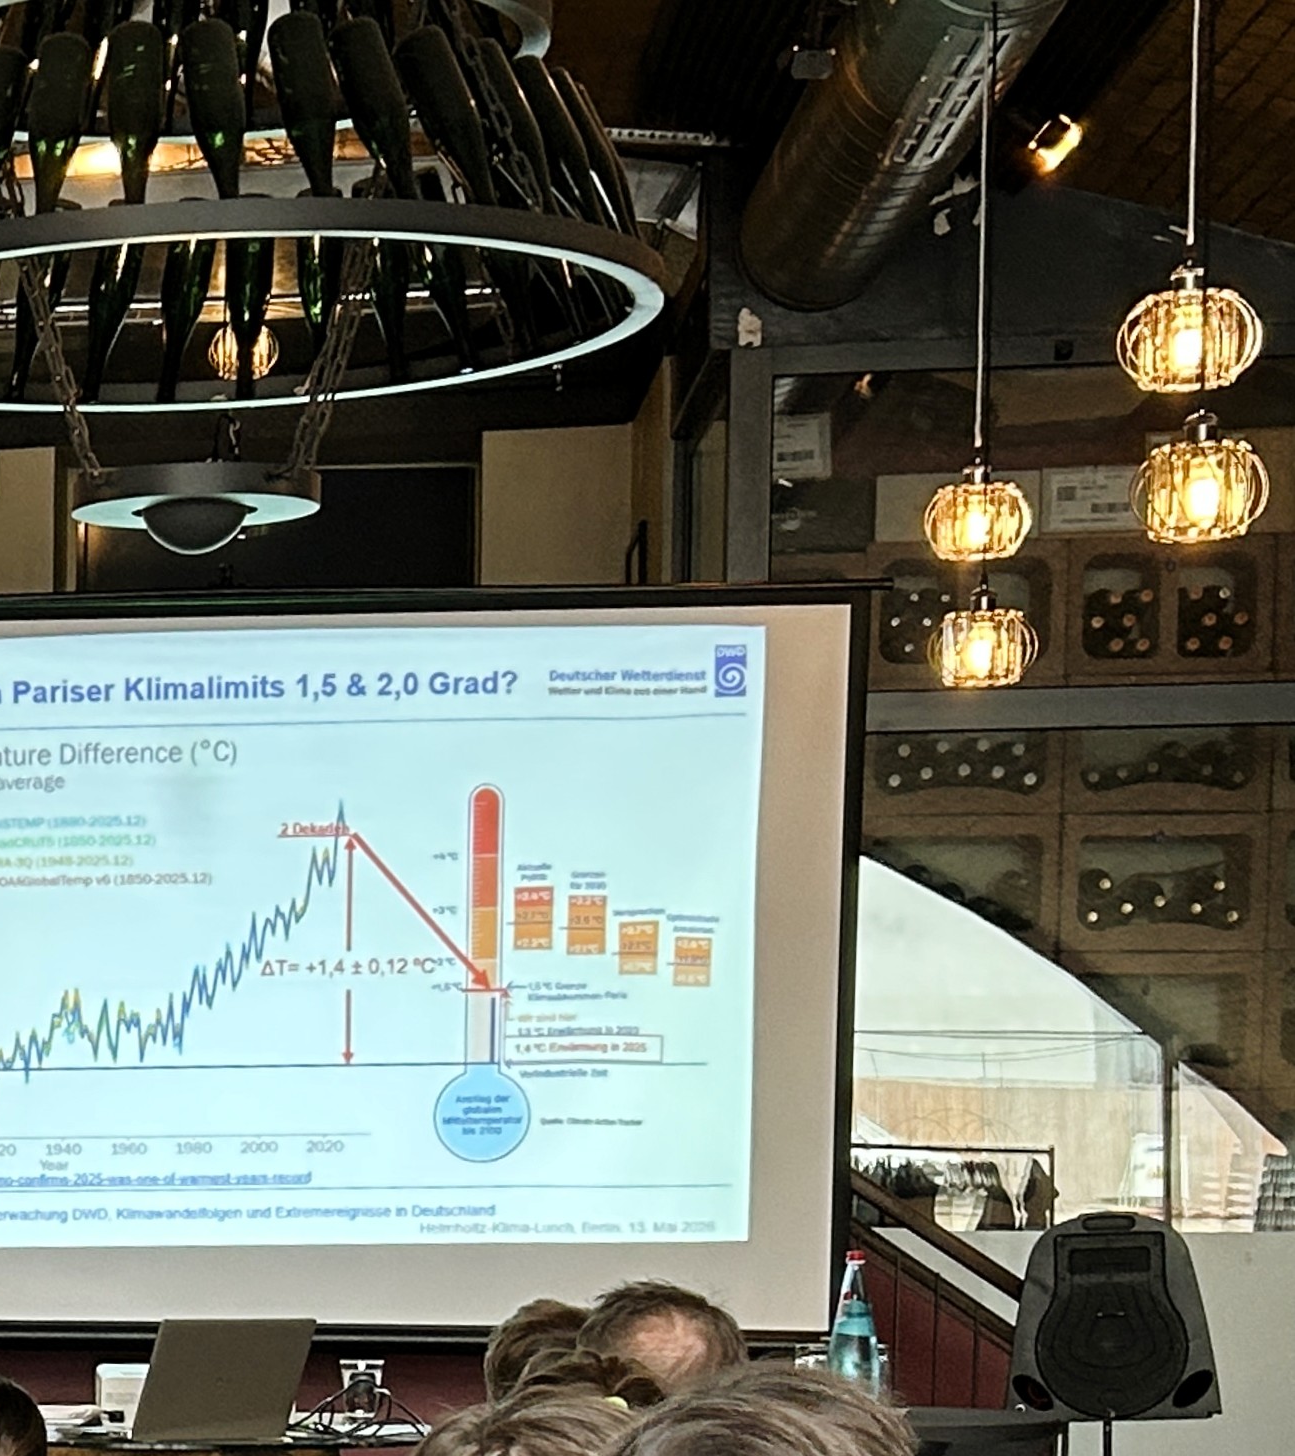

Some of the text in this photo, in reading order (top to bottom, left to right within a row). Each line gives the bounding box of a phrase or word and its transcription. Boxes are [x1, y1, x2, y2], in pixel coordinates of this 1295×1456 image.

[549, 669, 707, 681] Deutscher Wetterdienst
[12, 678, 114, 704] Pariser
[124, 674, 285, 701] Klimalimits
[295, 672, 337, 702] 1,5
[346, 673, 367, 697] &
[377, 672, 419, 701] 2,0
[428, 669, 518, 696] Grad?
[59, 742, 183, 766] Difference
[190, 739, 237, 767] (°C)
[280, 822, 350, 835] 2 Dekaden
[305, 958, 345, 978] +1,4
[351, 959, 363, 976] ±
[368, 958, 409, 977] 0,12
[45, 1142, 82, 1156] 1940
[111, 1142, 148, 1156] 1960
[176, 1141, 213, 1155] 1980
[240, 1140, 279, 1154] 2000
[306, 1139, 345, 1153] 2020
[39, 1159, 69, 1172] Year
[246, 1206, 272, 1219] und
[275, 1204, 391, 1220] Extremereignisse
[395, 1204, 408, 1217] in
[411, 1204, 496, 1218] Deutschland
